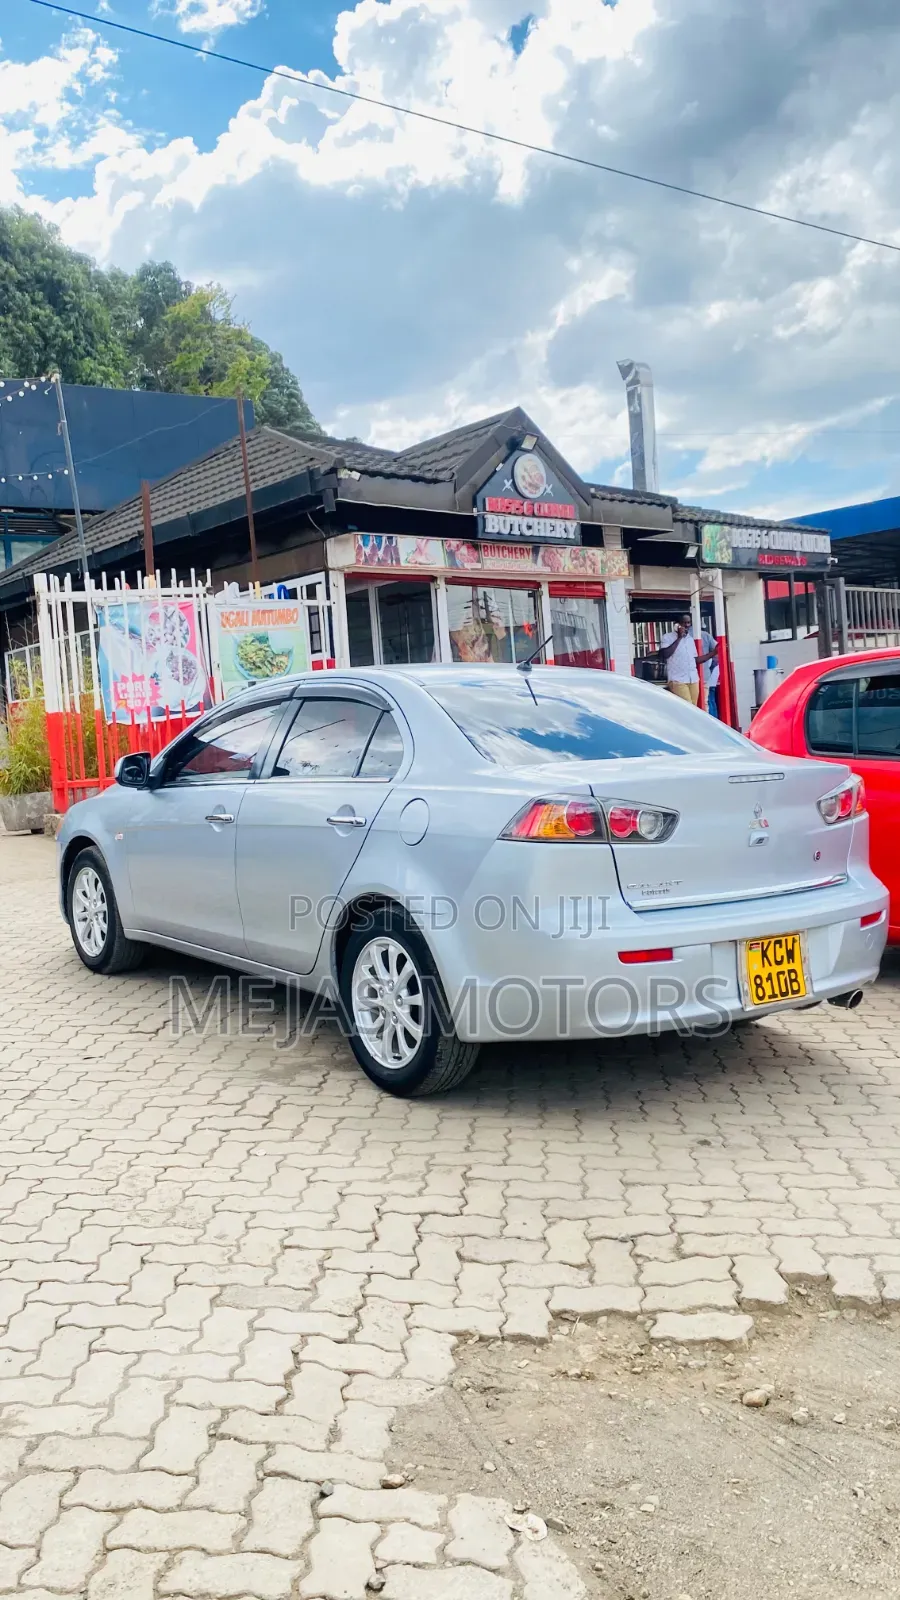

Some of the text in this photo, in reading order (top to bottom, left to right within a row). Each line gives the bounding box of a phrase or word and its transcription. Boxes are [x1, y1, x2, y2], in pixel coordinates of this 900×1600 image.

[484, 514, 577, 539] BUTCHERY
[482, 544, 531, 560] BUTCHERY
[757, 553, 808, 566] RIDGEWAYS
[220, 610, 249, 628] UGALI
[761, 937, 797, 968] KCW
[753, 968, 801, 1001] 810B
